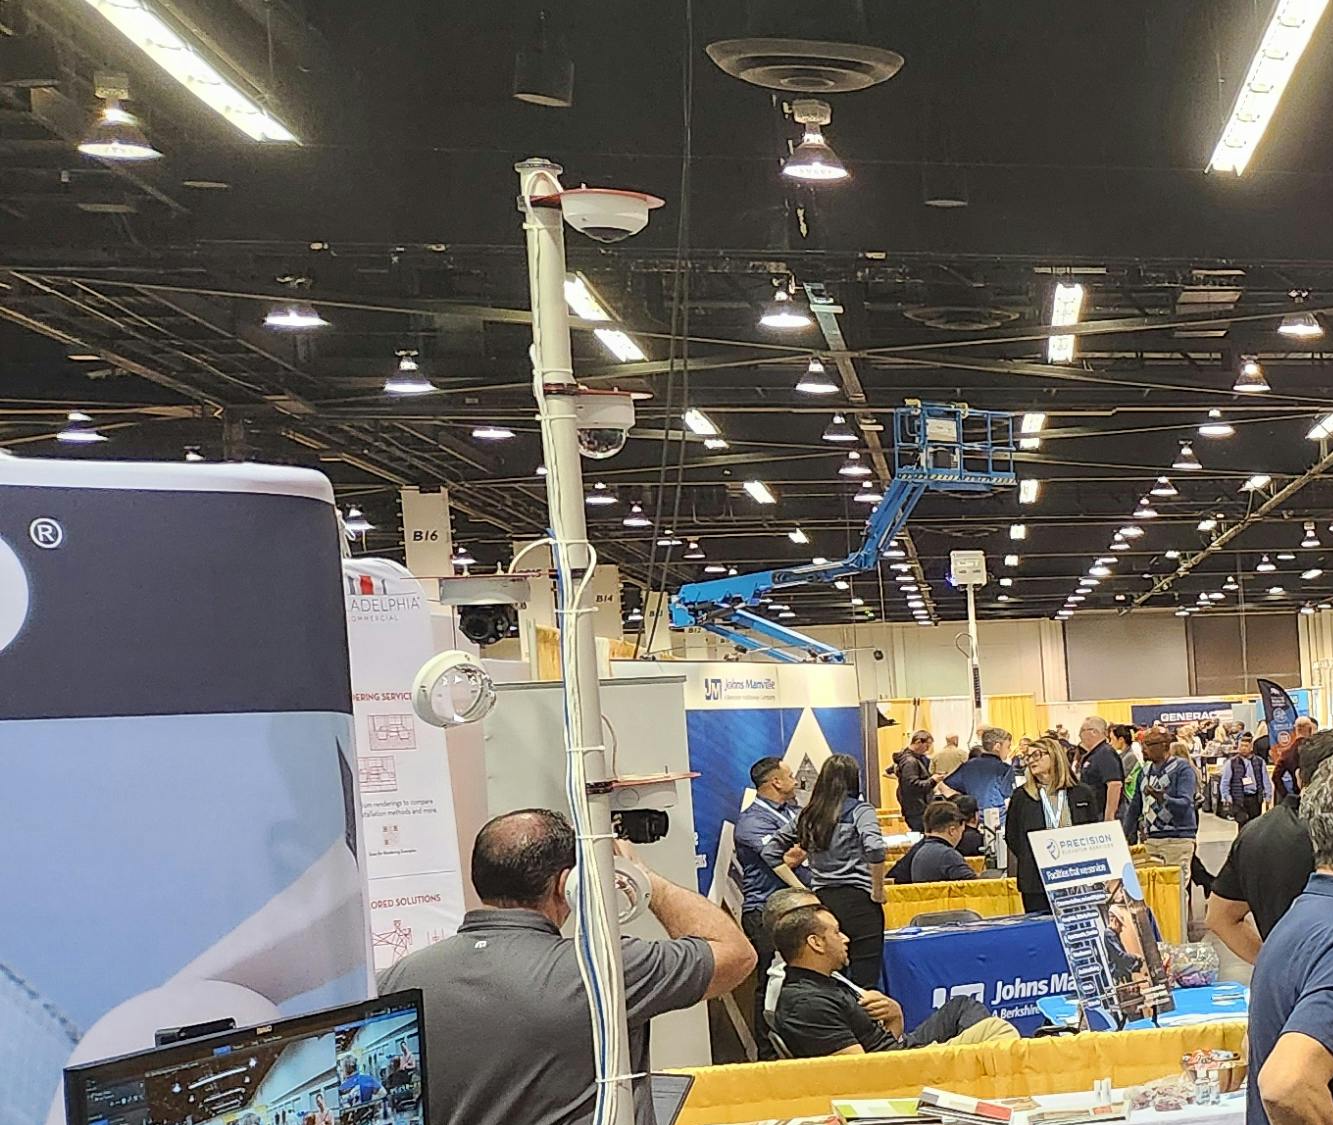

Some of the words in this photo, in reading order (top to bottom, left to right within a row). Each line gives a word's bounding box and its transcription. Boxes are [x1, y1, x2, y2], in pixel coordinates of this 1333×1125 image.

[412, 529, 439, 543] B16
[1060, 834, 1112, 849] PRECISION
[395, 894, 441, 906] SOLUTIONS
[990, 978, 1048, 1006] Johns
